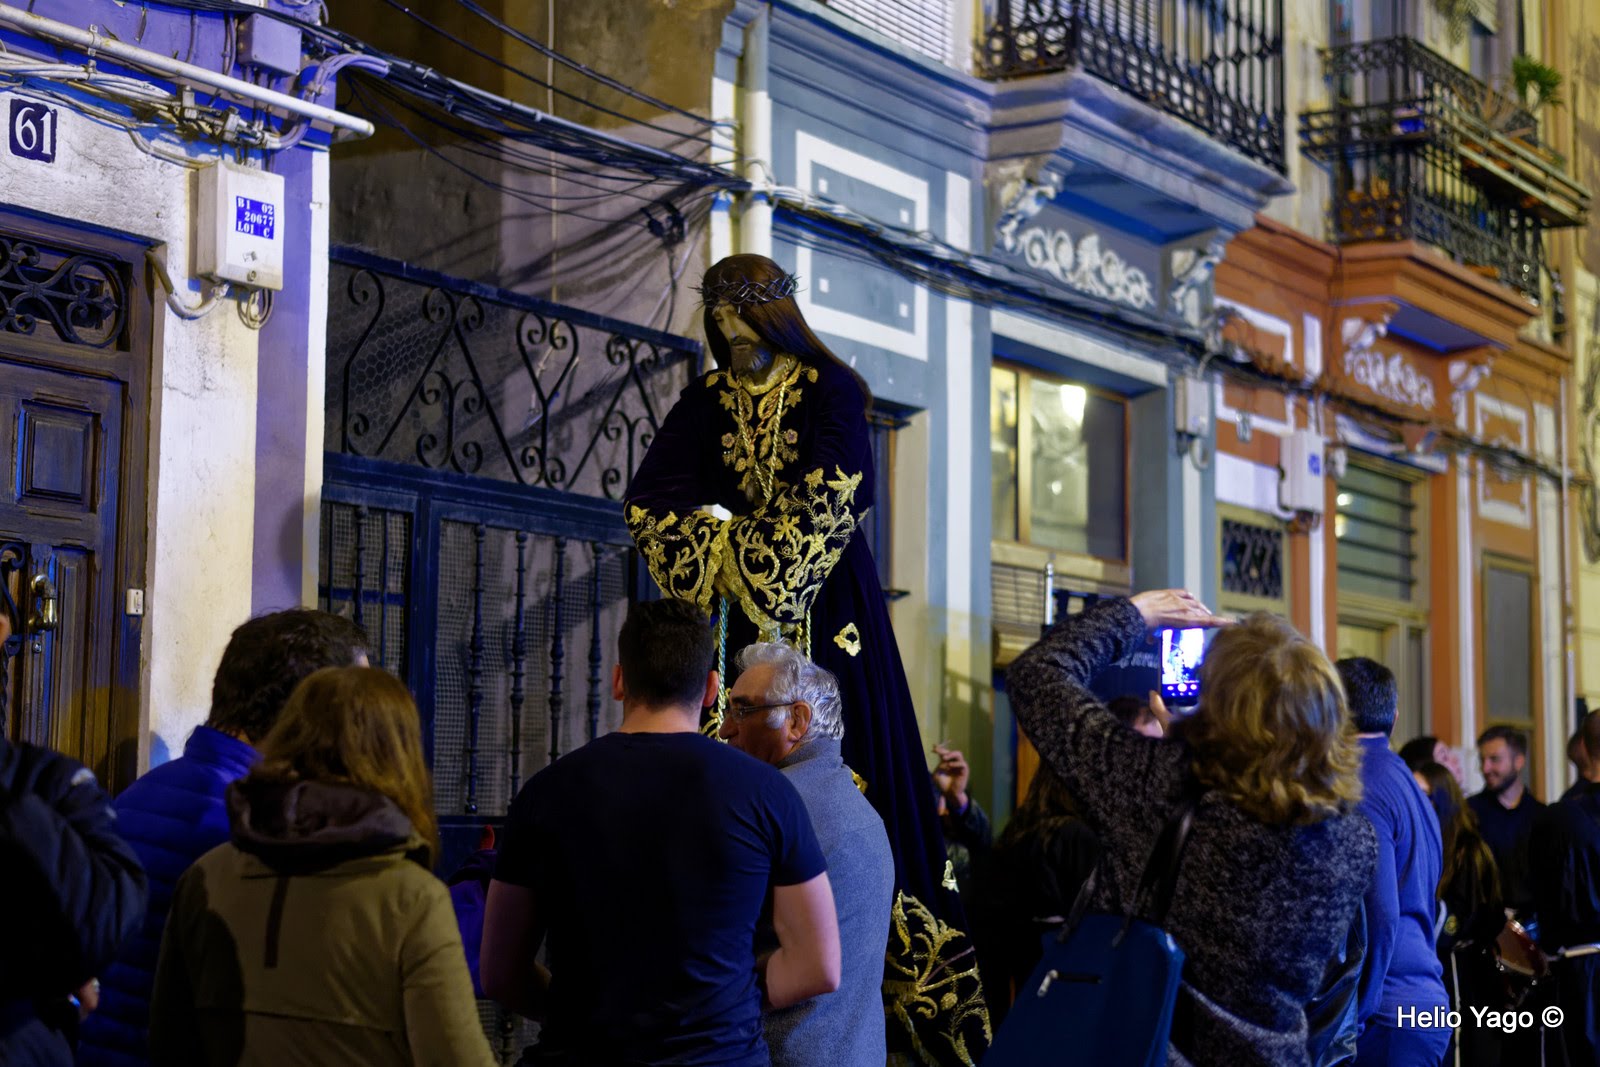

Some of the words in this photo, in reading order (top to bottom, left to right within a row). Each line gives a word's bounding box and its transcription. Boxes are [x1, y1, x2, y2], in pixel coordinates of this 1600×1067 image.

[15, 106, 52, 155] 61
[261, 203, 274, 215] 02
[244, 211, 274, 227] 20677
[263, 227, 270, 238] C
